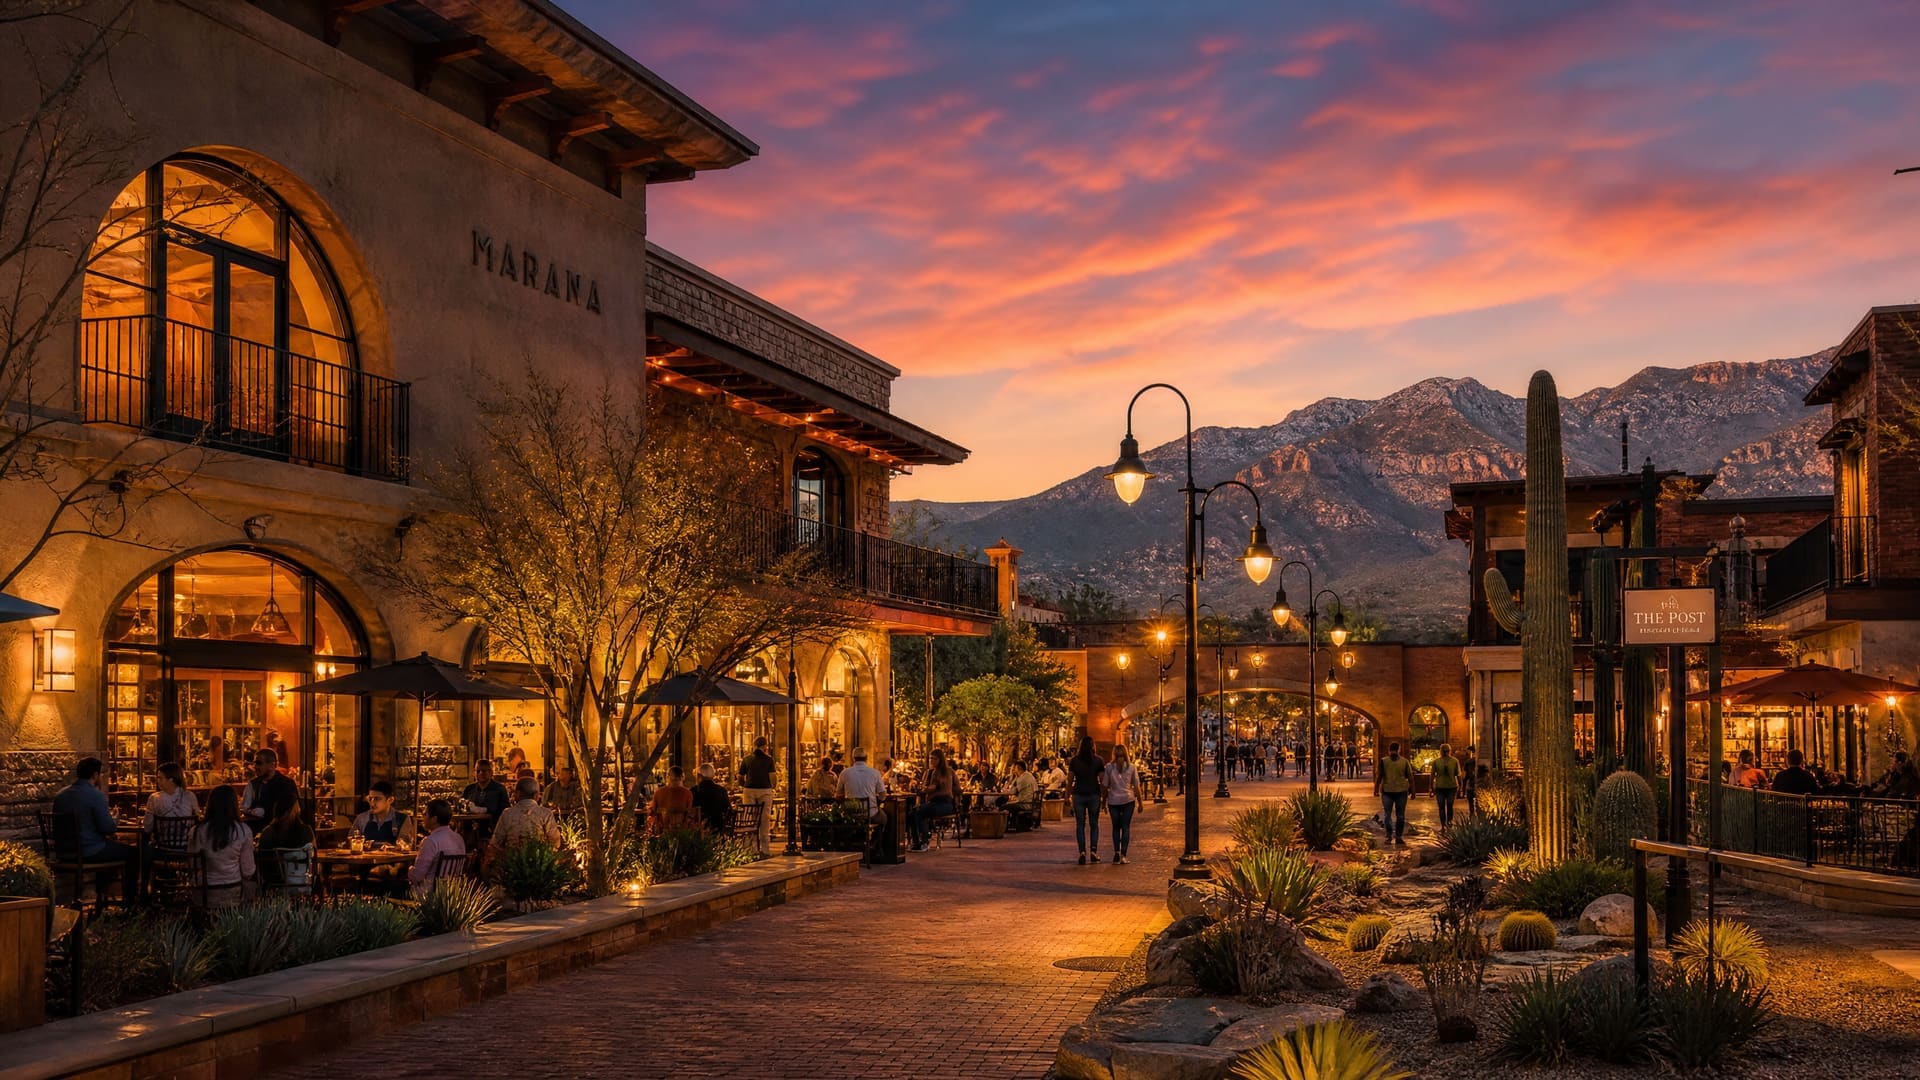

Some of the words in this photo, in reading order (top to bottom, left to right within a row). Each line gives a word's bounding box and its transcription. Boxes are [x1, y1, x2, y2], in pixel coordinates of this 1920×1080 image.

[472, 230, 601, 315] MARANA
[1633, 612, 1664, 624] THE
[1669, 611, 1706, 624] POST
